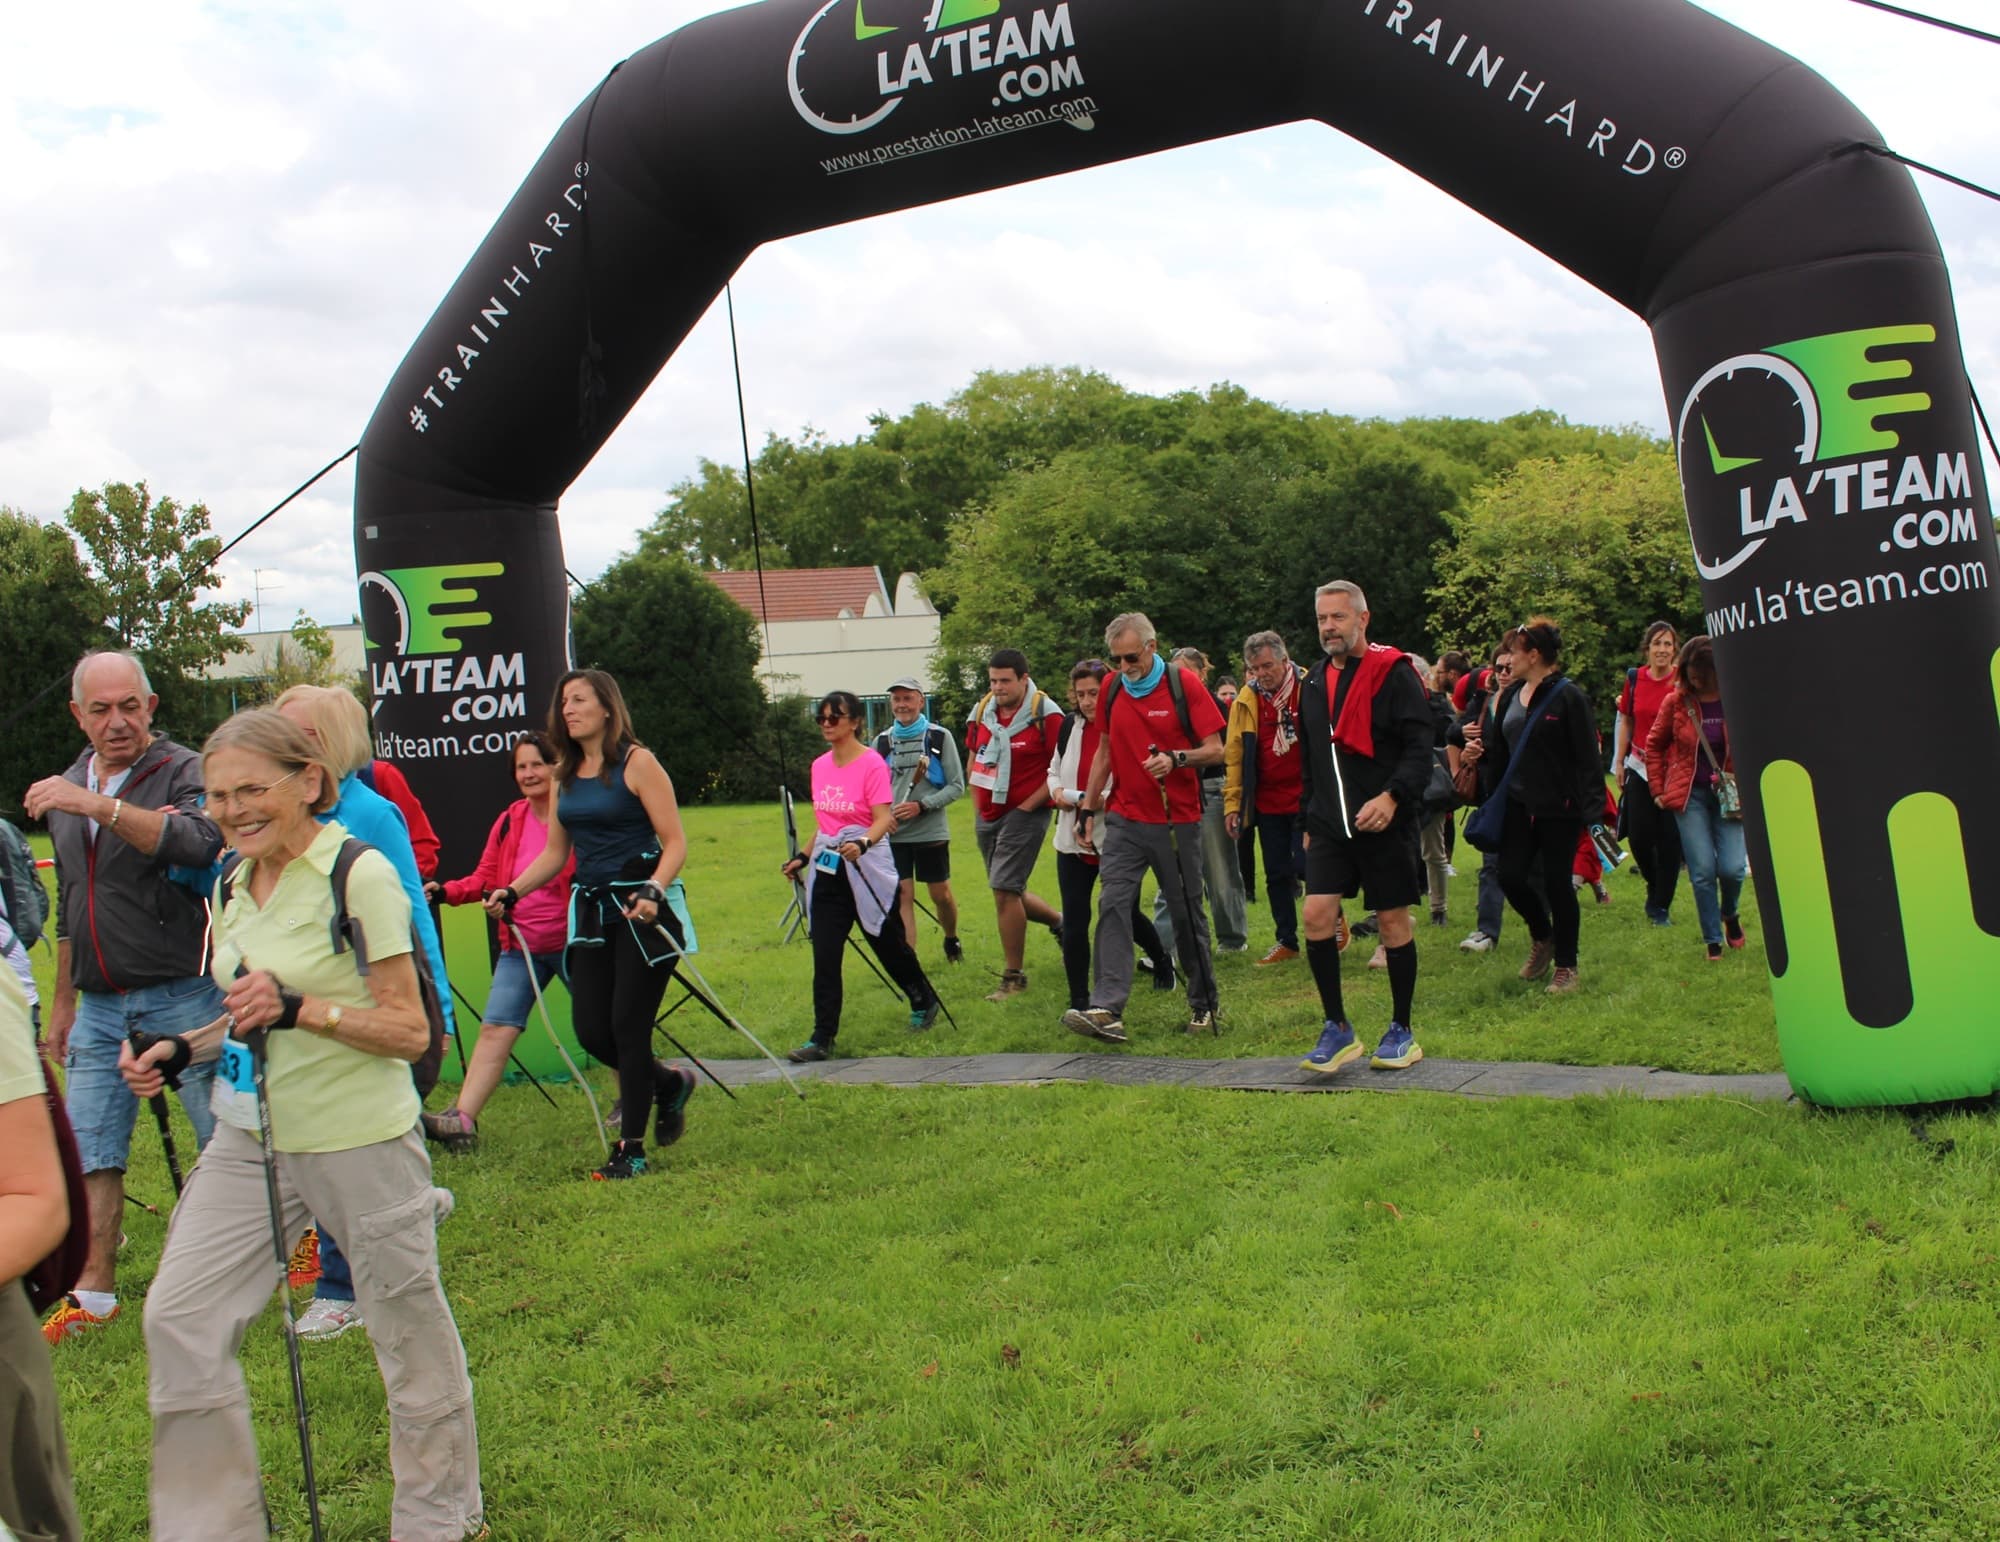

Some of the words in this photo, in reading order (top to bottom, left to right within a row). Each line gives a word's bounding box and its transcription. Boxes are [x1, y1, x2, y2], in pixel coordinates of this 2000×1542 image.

[877, 3, 1076, 95] LA'TEAM
[991, 56, 1085, 107] .COM
[820, 96, 1097, 173] www.prestation-lateam.com
[1740, 452, 1973, 536] LA'TEAM
[1879, 508, 1978, 553] .COM
[372, 653, 526, 696] LA'TEAM
[442, 692, 526, 724] .COM
